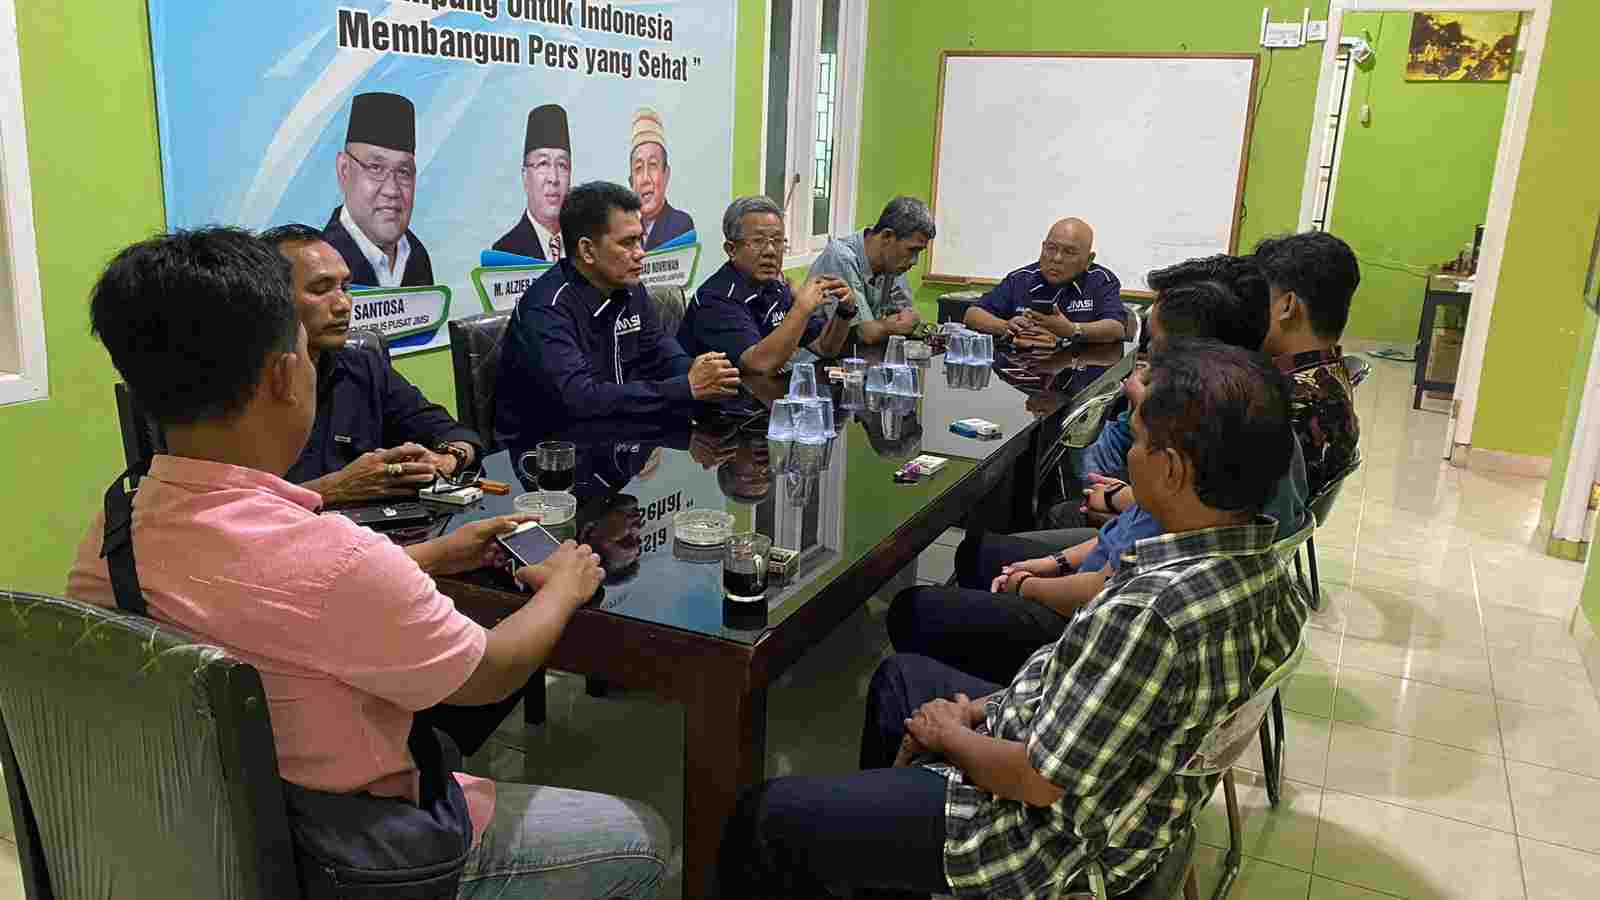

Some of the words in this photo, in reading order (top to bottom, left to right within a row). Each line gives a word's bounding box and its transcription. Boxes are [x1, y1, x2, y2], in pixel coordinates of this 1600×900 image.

[508, 0, 573, 26] Untuk
[581, 0, 673, 41] Indonesia
[338, 10, 520, 64] Membangun
[528, 34, 578, 69] Pers
[586, 47, 632, 78] yang
[639, 49, 688, 81] Sehat
[354, 299, 405, 320] SANTOSA
